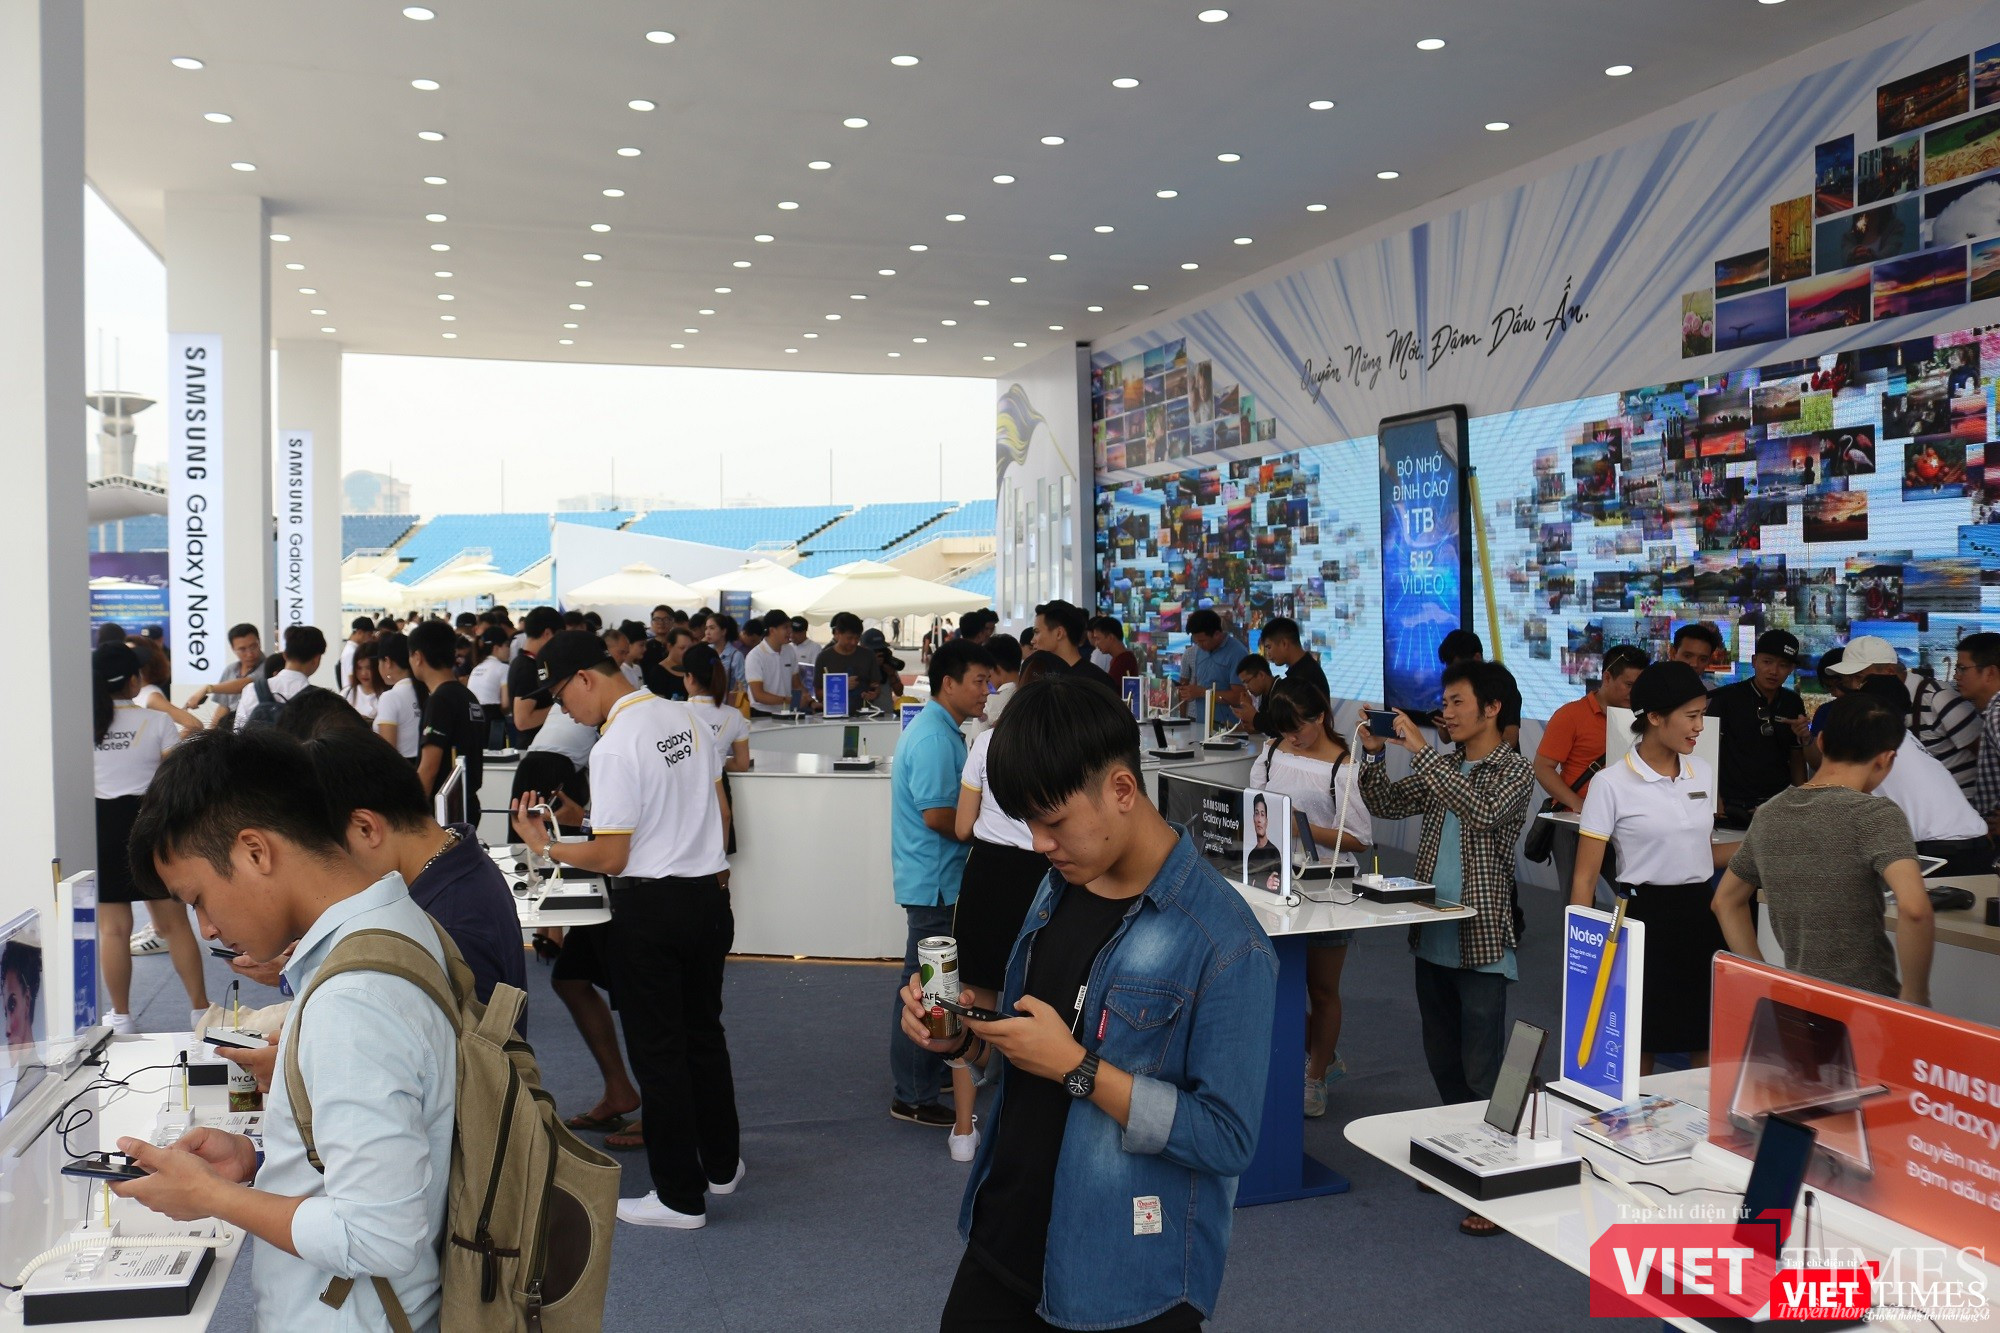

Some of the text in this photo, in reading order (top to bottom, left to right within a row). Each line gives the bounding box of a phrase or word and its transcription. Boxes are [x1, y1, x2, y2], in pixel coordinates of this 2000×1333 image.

[1344, 345, 1382, 390] Năng
[1427, 325, 1482, 371] Đậm
[1488, 304, 1536, 357] Dấu
[1396, 450, 1443, 479] BỘ NHỚ
[288, 438, 303, 525] SAMSUNG
[1422, 479, 1449, 498] CAO
[180, 347, 210, 672] SAMSUNG Galaxy Note9
[1403, 507, 1435, 535] 1TB
[285, 532, 304, 595] Galaxy
[1410, 551, 1434, 572] 512
[1400, 573, 1445, 595] VIDEO
[102, 731, 137, 740] alaxy
[656, 729, 693, 753] Galaxy
[1203, 798, 1229, 813] SAMSUNG
[1203, 812, 1240, 830] Galaxy Note9
[1570, 925, 1604, 947] Note9
[1075, 986, 1086, 1009] SAMSUNG
[1909, 1091, 2000, 1150] Galaxy
[1907, 1134, 1966, 1170] Quyền
[1906, 1160, 1948, 1190] Đậm
[1951, 1179, 1987, 1206] dấu
